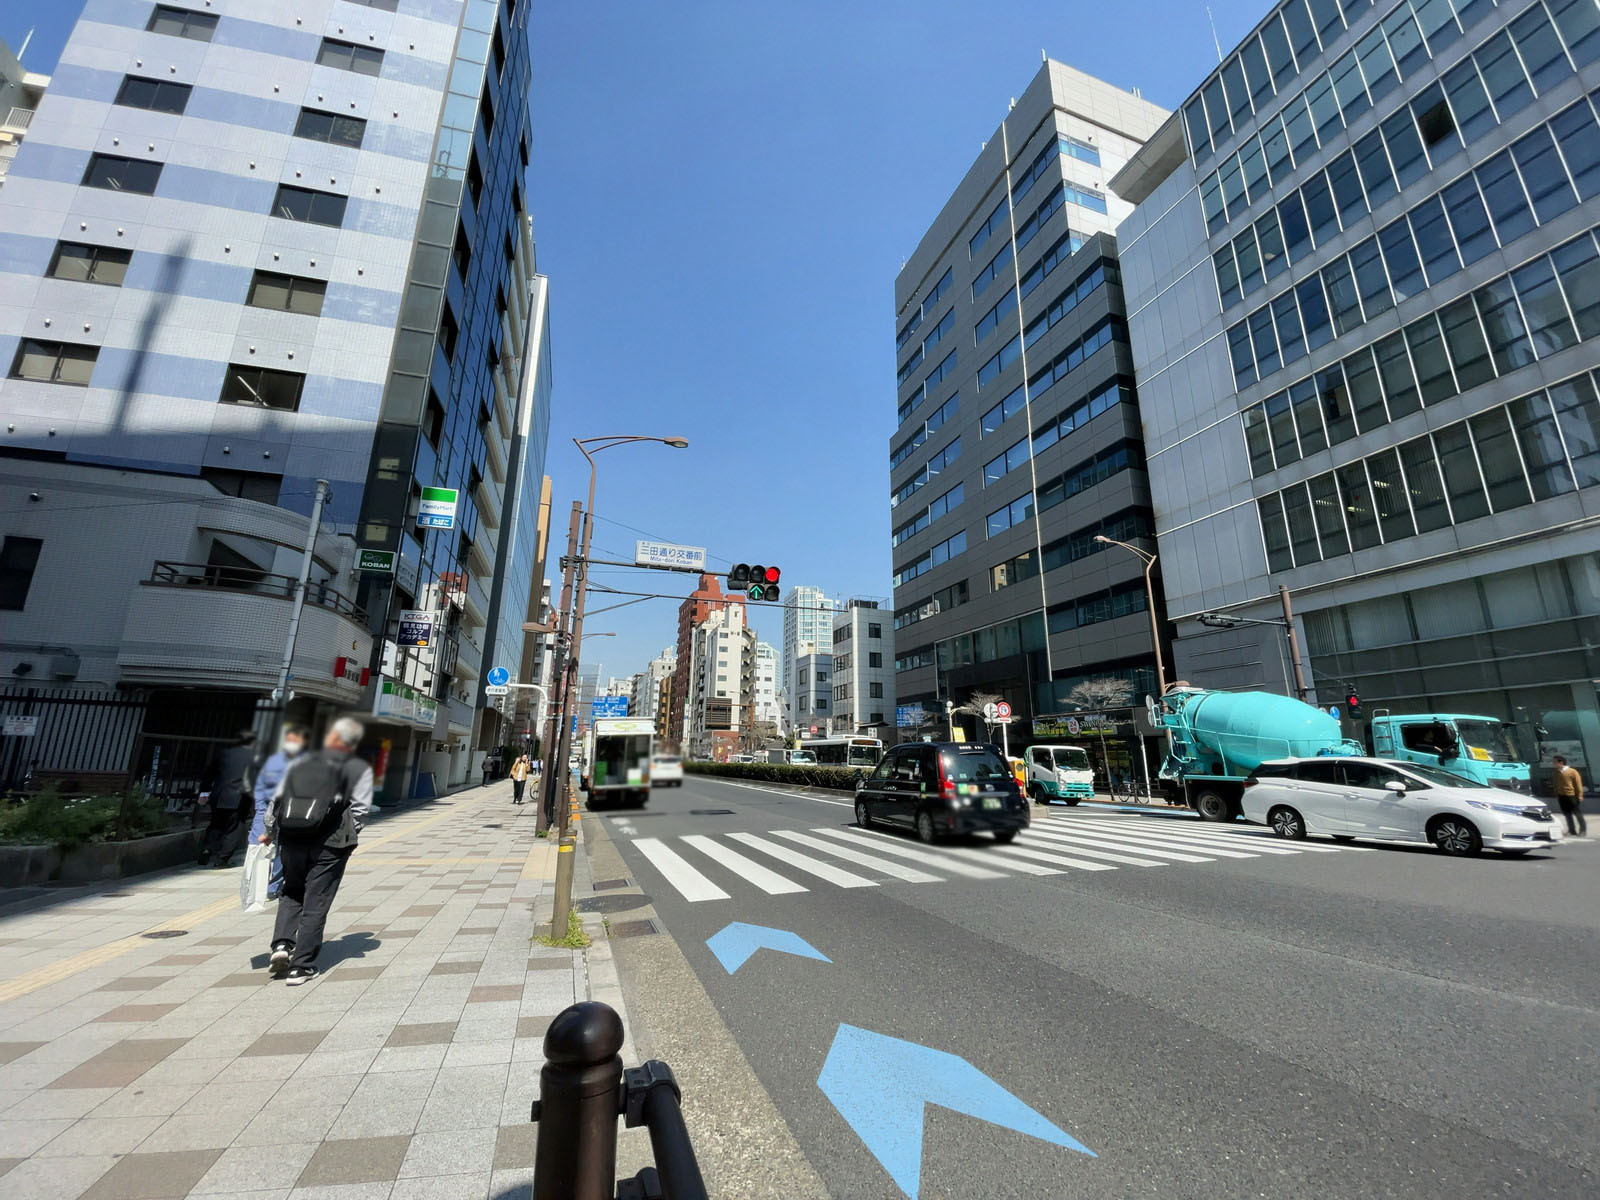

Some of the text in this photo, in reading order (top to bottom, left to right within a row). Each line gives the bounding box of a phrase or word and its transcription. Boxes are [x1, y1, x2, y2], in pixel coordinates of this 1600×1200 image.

[422, 503, 453, 511] FamilyMart
[432, 518, 450, 526] たばこ
[641, 545, 703, 561] 三田通り交番前
[361, 561, 390, 569] KOBAN
